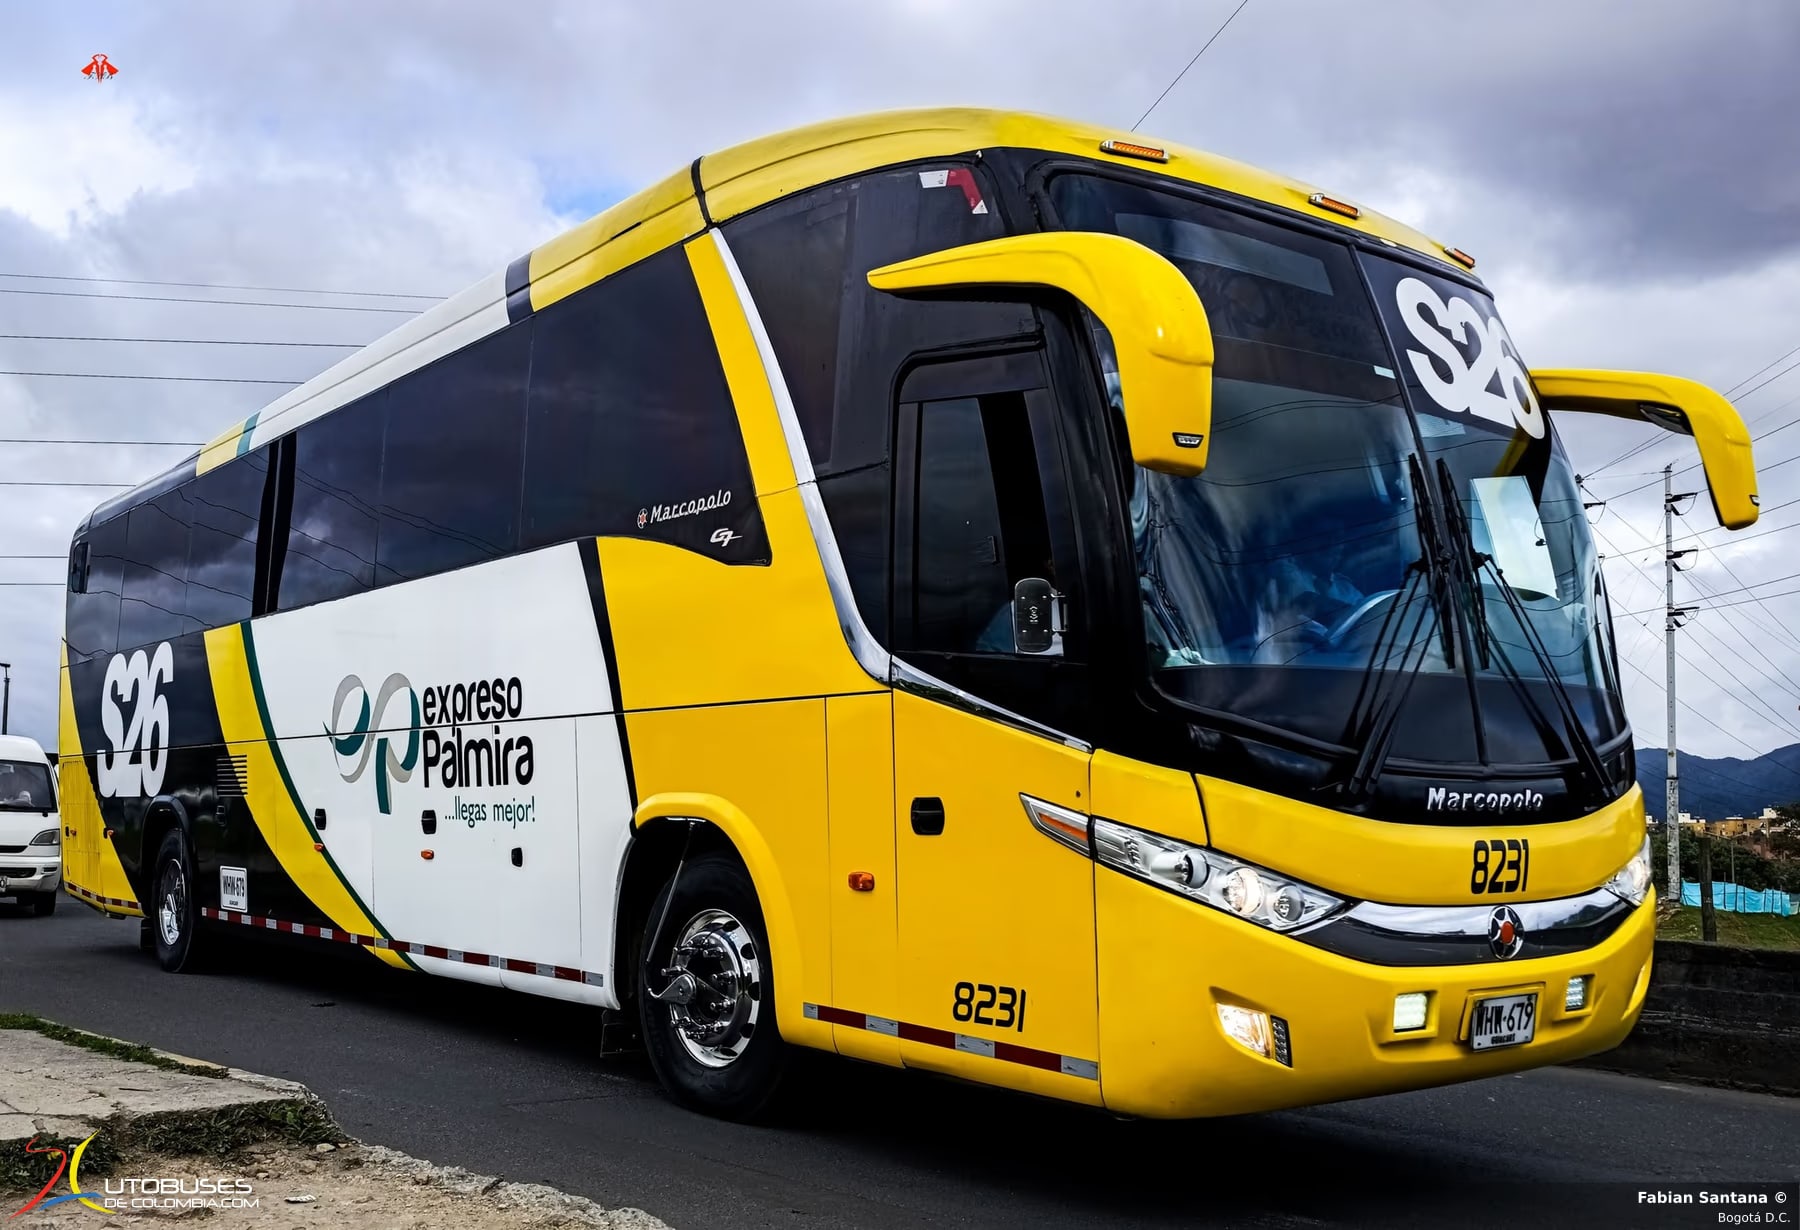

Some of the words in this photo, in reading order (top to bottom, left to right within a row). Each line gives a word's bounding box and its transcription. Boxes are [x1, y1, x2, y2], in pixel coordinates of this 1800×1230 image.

[1396, 277, 1545, 439] S26
[650, 489, 732, 524] Marcopolo
[97, 641, 174, 798] S26
[422, 676, 523, 738] expreso
[422, 724, 535, 789] Palmira
[492, 795, 536, 829] mejor!
[1426, 787, 1544, 815] Marcopolo
[1470, 838, 1530, 895] 8231
[952, 981, 1027, 1033] 8231
